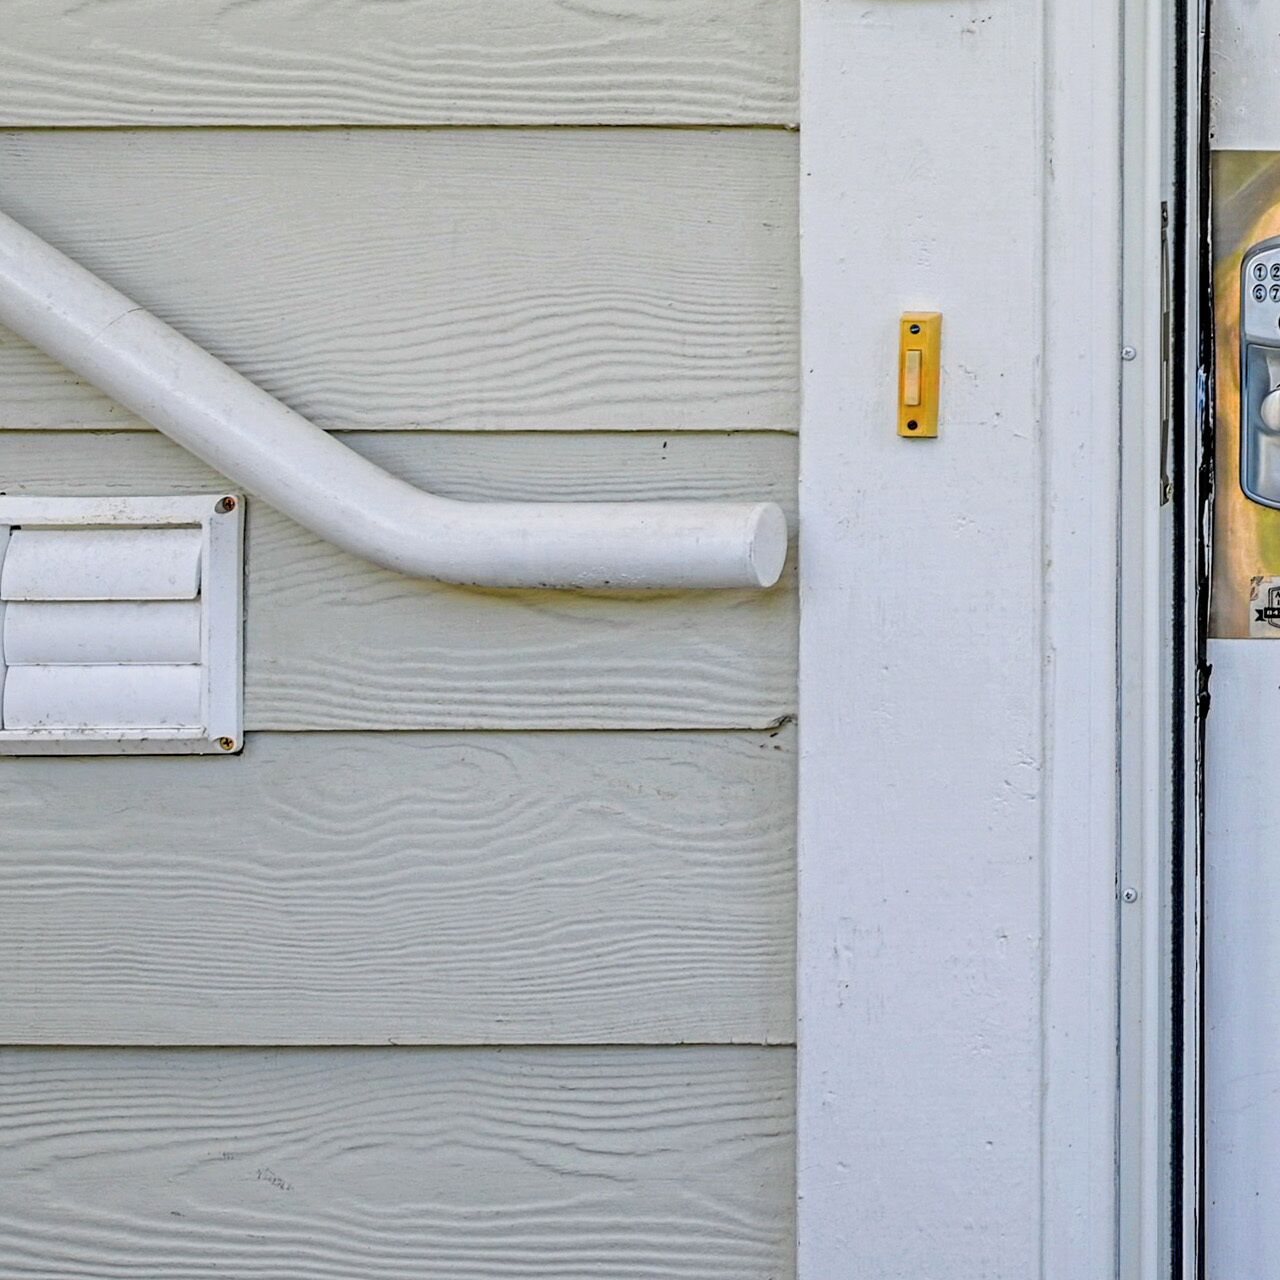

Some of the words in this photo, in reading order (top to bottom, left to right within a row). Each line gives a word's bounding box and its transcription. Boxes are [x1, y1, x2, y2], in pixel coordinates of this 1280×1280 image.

[1256, 266, 1263, 278] 1
[1273, 266, 1280, 278] 2
[1256, 288, 1262, 300] 6
[1272, 288, 1279, 300] 7
